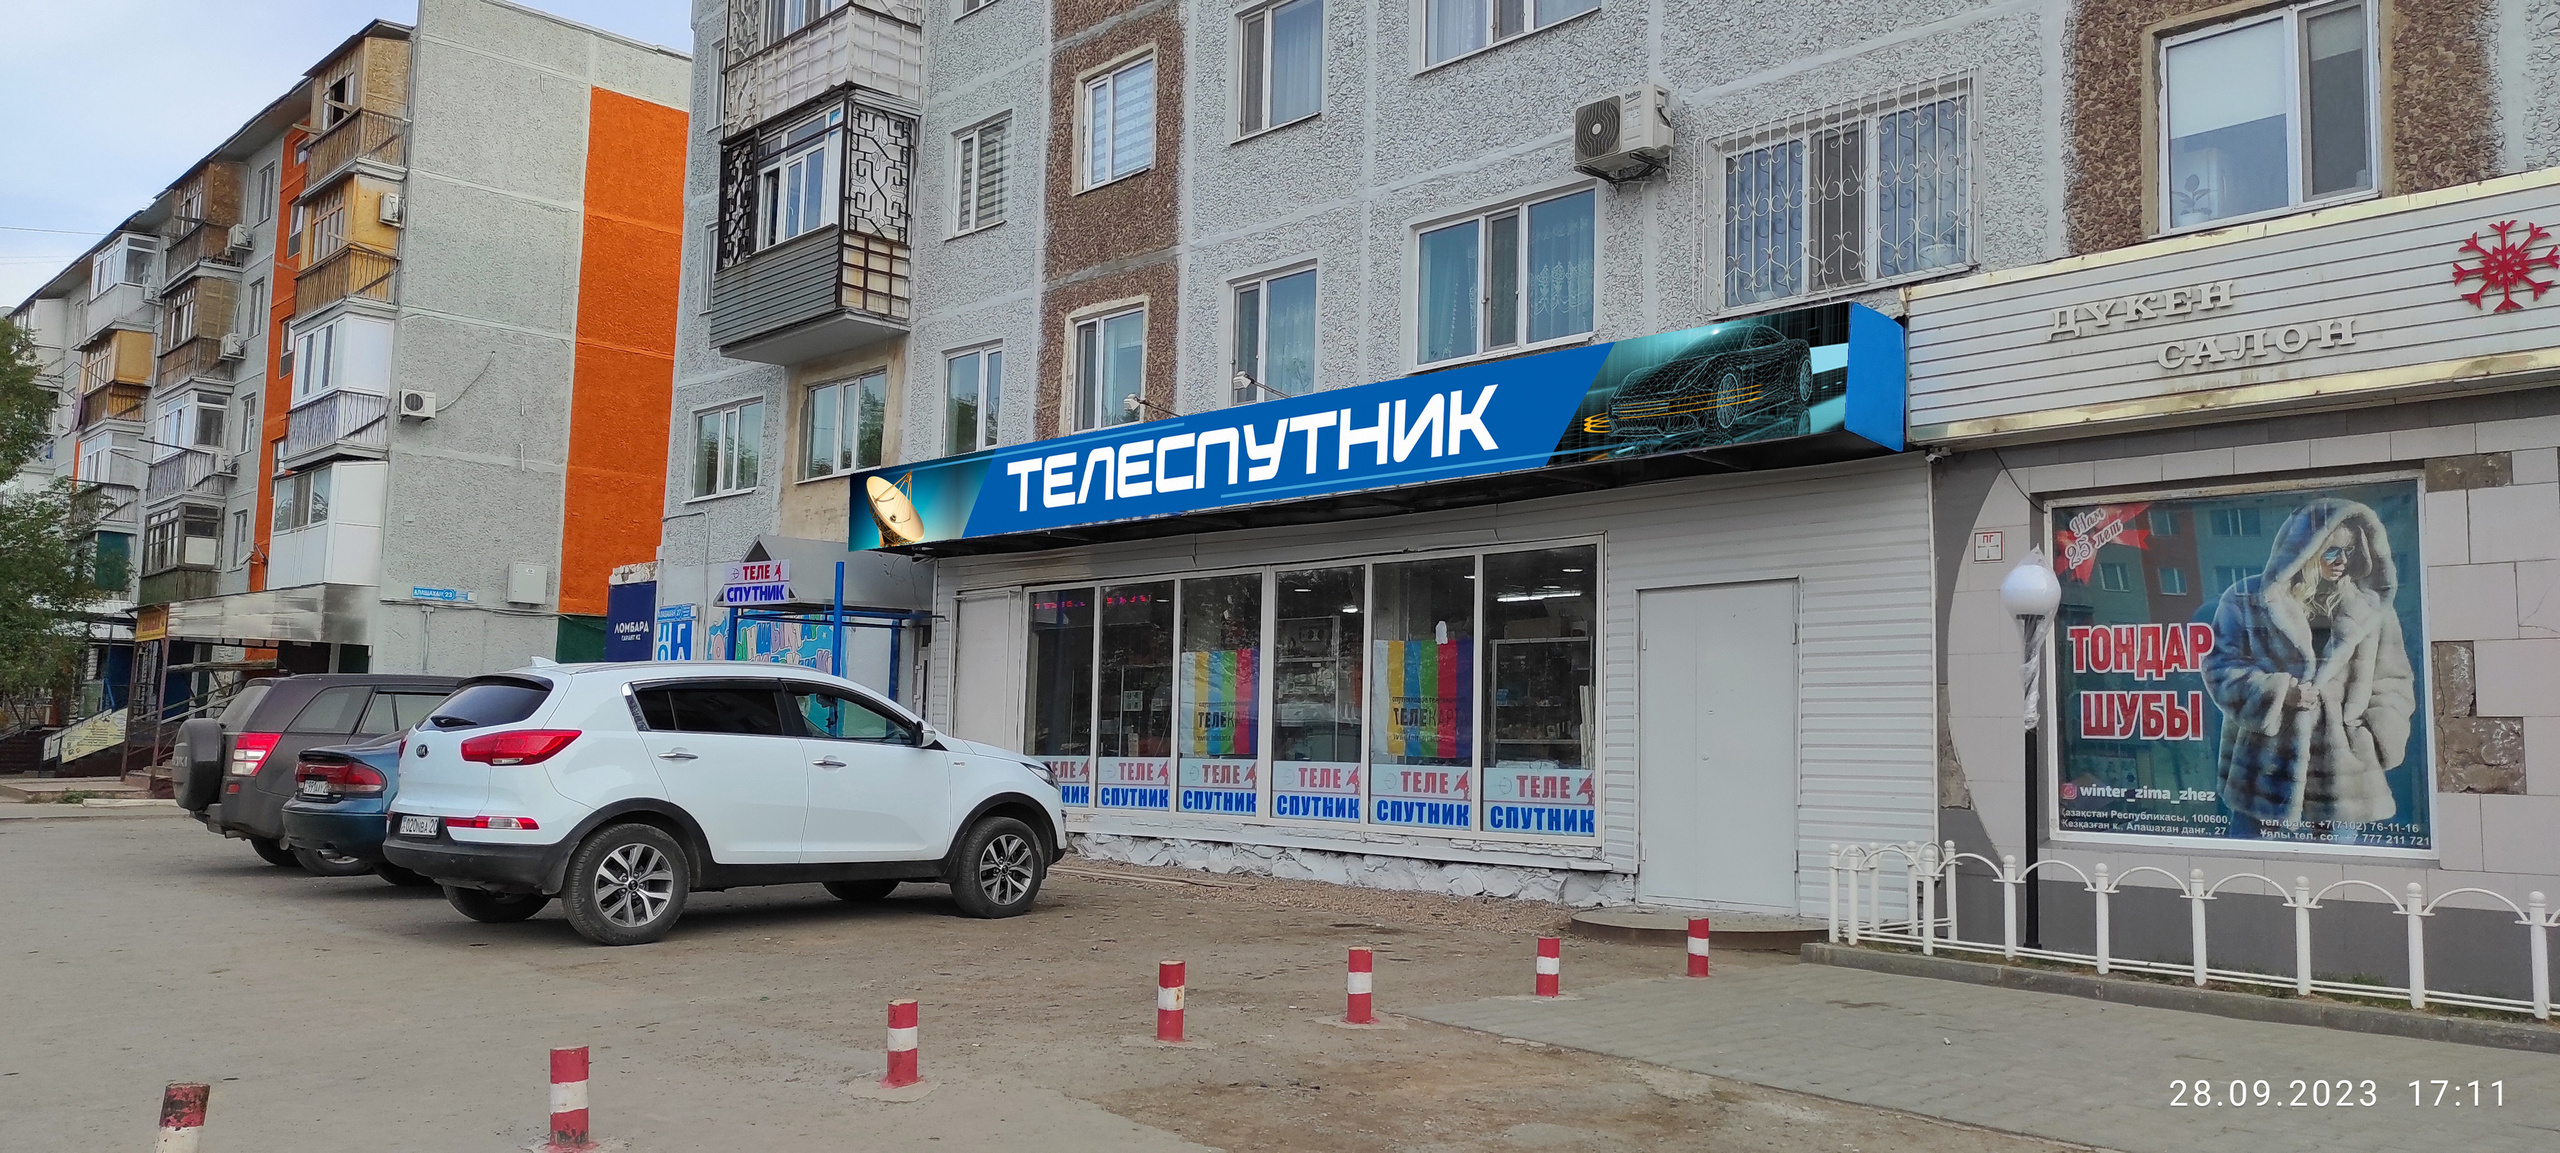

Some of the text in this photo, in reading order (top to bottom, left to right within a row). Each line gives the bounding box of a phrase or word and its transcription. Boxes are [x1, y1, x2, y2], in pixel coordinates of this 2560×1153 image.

[2157, 318, 2356, 369] САЛОН
[1007, 384, 1499, 512] ТЕЛЕСПУТНИК
[2071, 508, 2105, 537] Нам
[2066, 520, 2123, 569] 25 лет
[743, 565, 770, 580] ТЕЛЕ
[727, 585, 785, 602] СПУТНИК
[614, 621, 649, 634] ЛОМБАРД
[2067, 623, 2215, 681] ТОНДАР
[2080, 691, 2203, 741] ШУБЫ
[1119, 762, 1154, 781] ТЕЛЕ
[1202, 764, 1240, 784] ТЕЛЕ
[1298, 768, 1341, 788] ТЕЛЕ
[1401, 771, 1449, 794] ТЕЛЕ
[1101, 787, 1169, 808] СПУТНИК
[1516, 775, 1570, 799] ТЕЛЕ
[2080, 784, 2216, 804] winter_zima_zhez
[1182, 789, 1256, 813] СПУТНИК
[1276, 794, 1360, 819] СПУТНИК
[1377, 799, 1469, 827] СПУТНИК
[1490, 805, 1594, 833] СПУТНИК
[2191, 814, 2231, 825] 100600,
[2126, 822, 2179, 833] Алашахан
[2214, 827, 2227, 835] 27
[2318, 820, 2367, 832] +7(7102)
[2370, 822, 2419, 833] 76-11-16
[2361, 834, 2382, 844] 777
[2386, 835, 2405, 845] 211
[2409, 836, 2429, 846] 721
